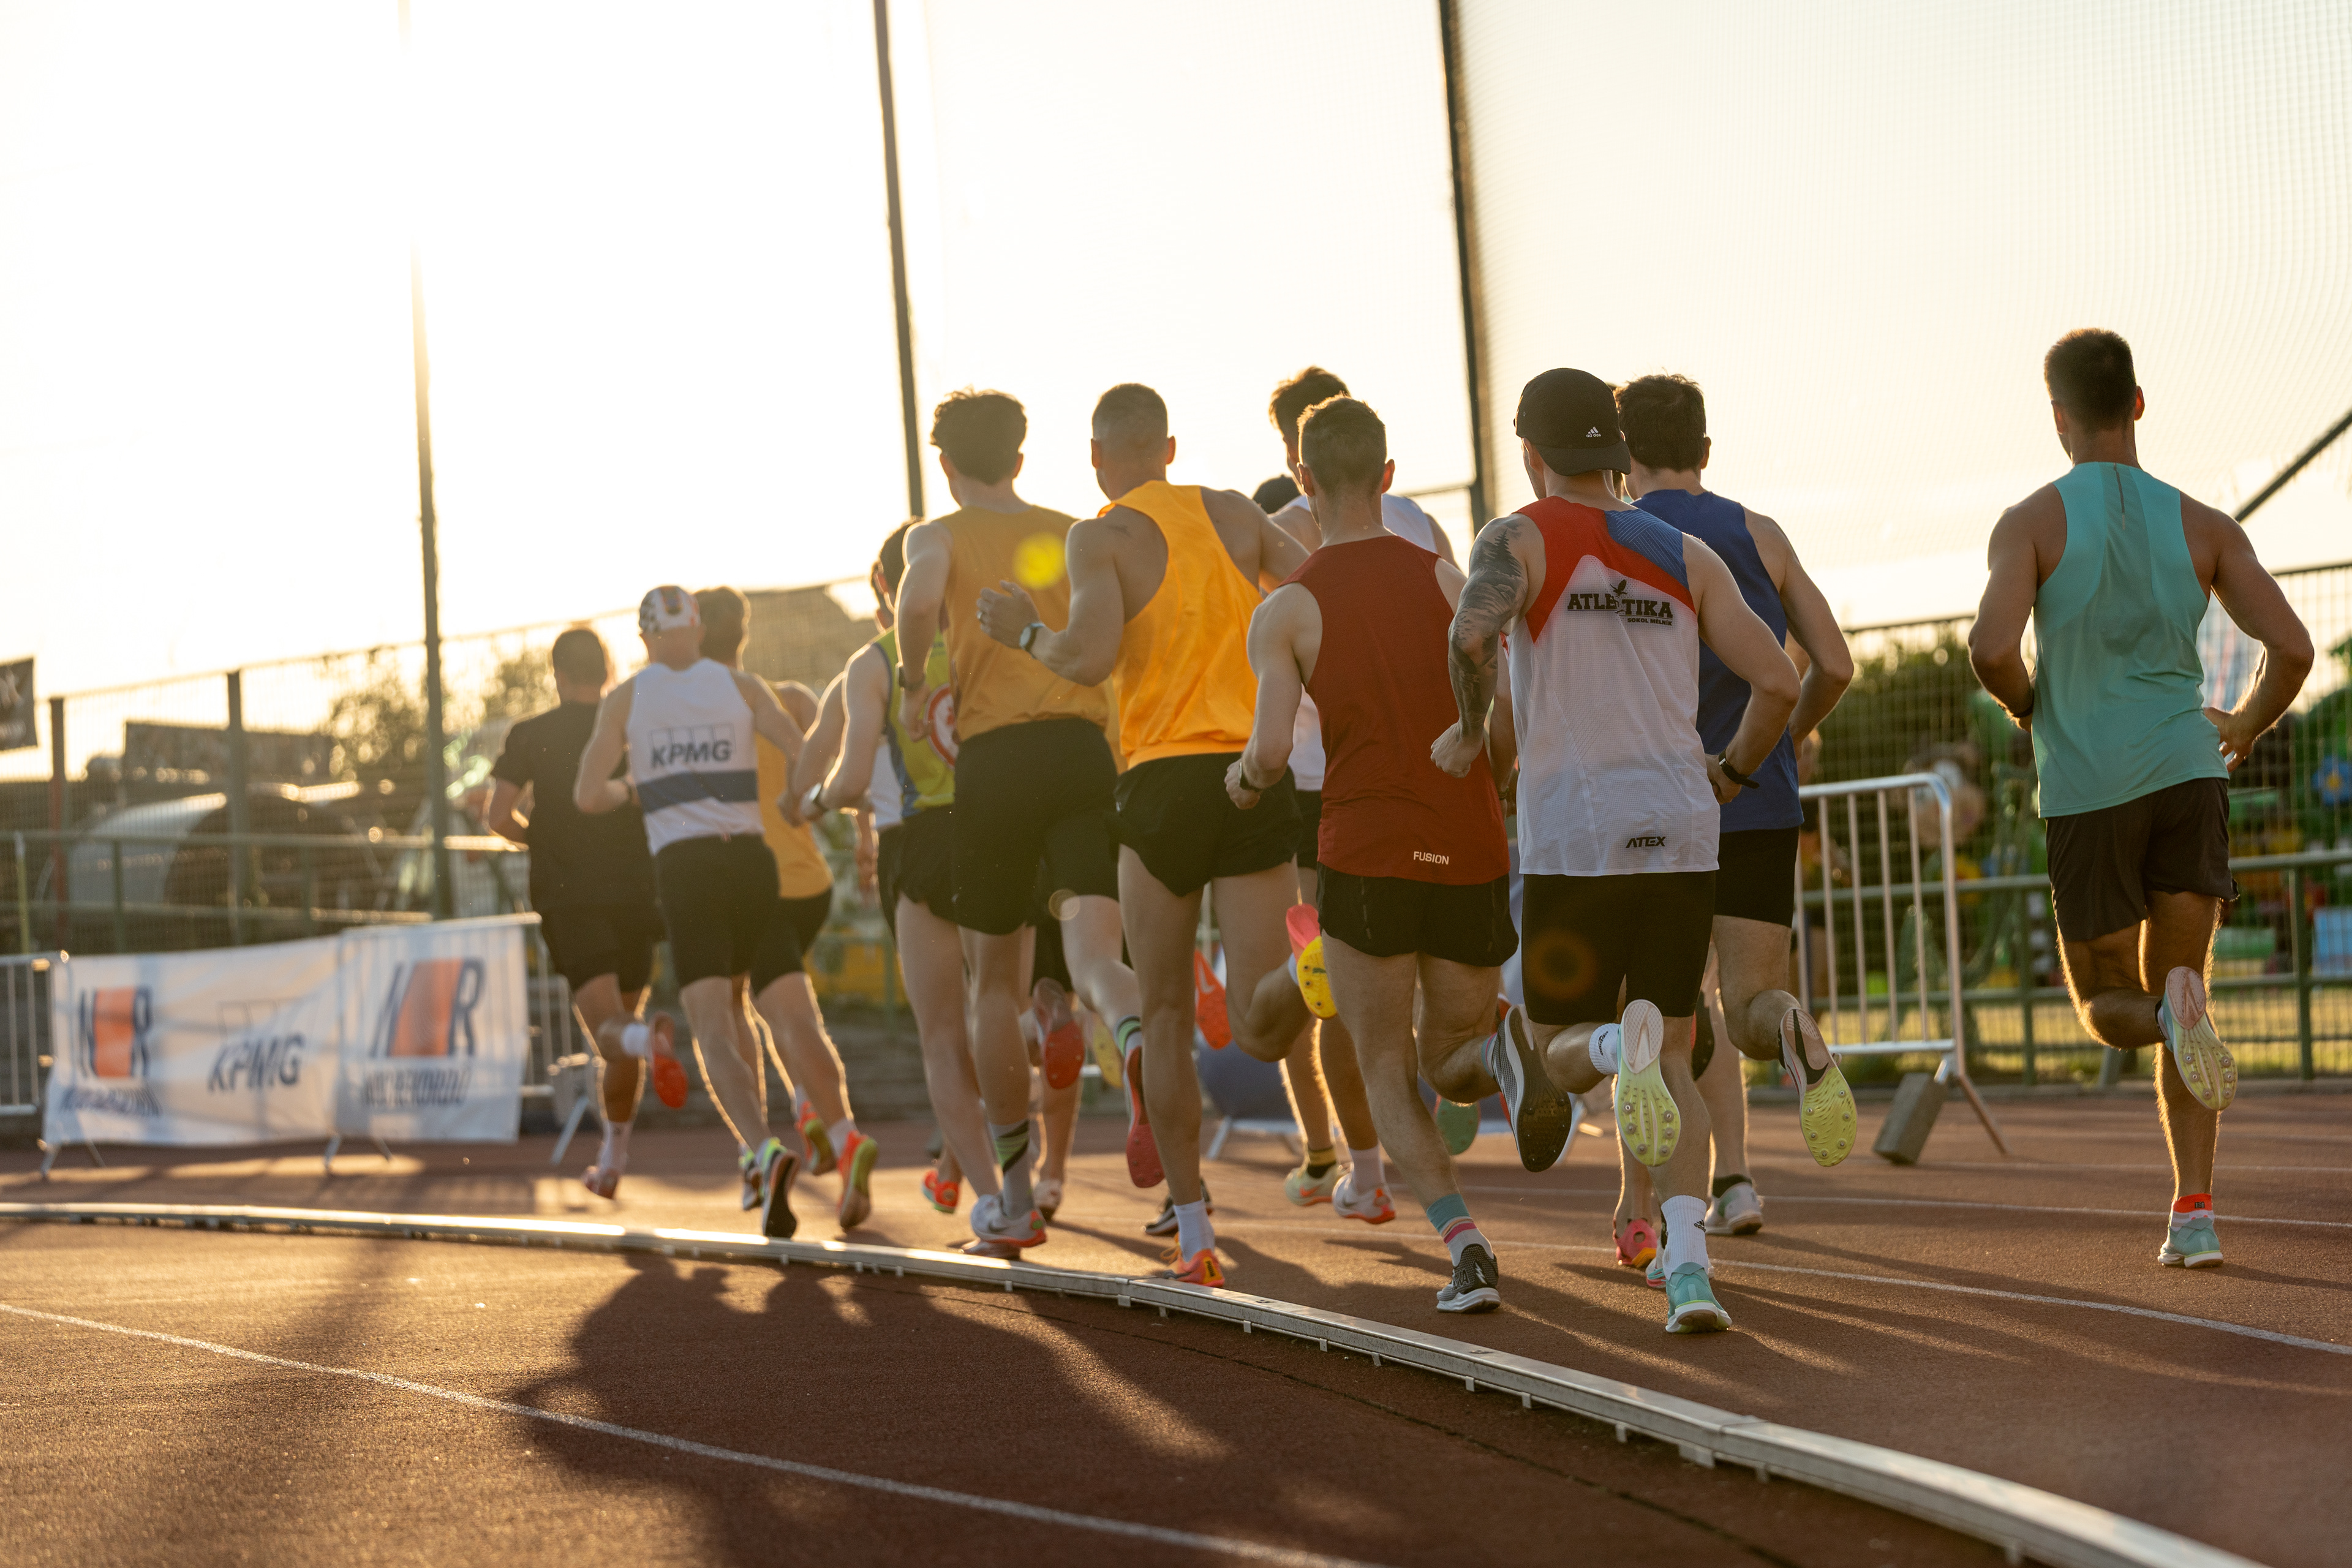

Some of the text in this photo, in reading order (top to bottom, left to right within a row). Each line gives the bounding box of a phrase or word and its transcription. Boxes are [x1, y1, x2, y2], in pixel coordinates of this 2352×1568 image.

[650, 740, 732, 768] KPMG
[1626, 836, 1666, 848] ATEX
[1414, 851, 1449, 865] FUSION
[208, 1033, 304, 1093] KPMG
